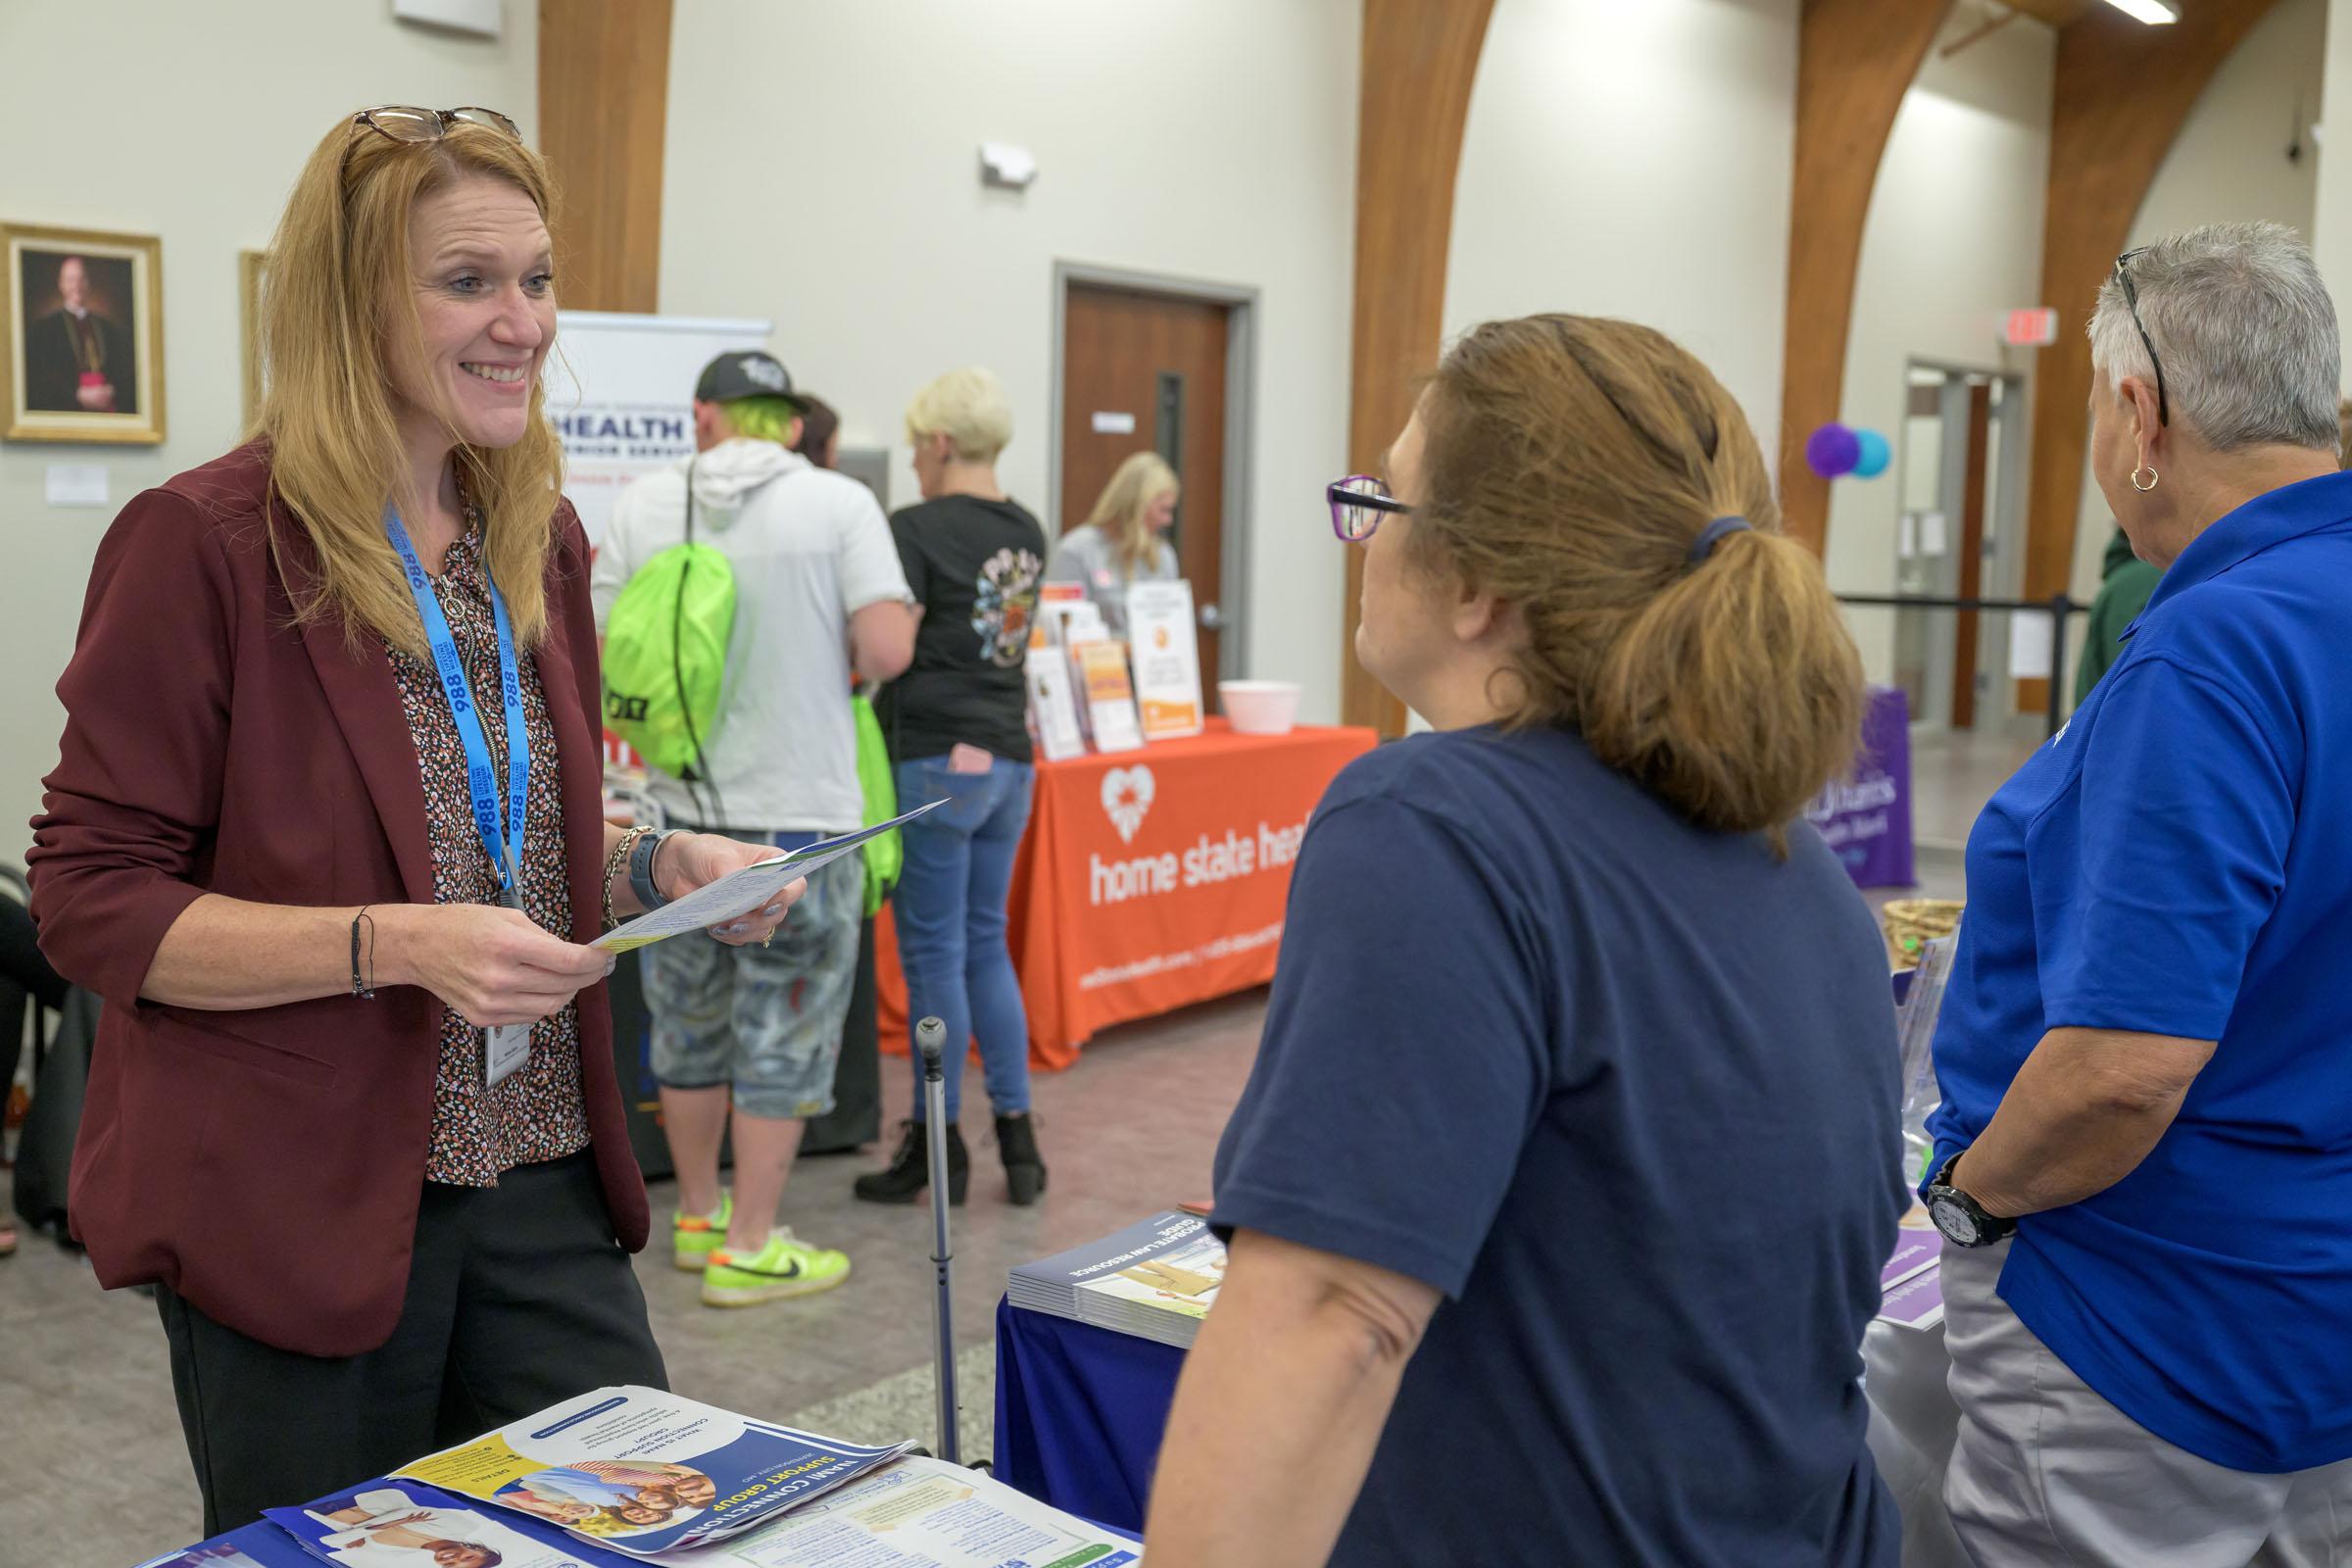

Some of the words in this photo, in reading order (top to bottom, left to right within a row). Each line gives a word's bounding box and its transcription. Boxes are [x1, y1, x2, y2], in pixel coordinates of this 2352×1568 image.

[554, 416, 683, 440] HEALTH
[402, 553, 426, 590] 988
[446, 674, 470, 712] 988
[504, 671, 519, 708] 988
[475, 767, 485, 795] LIFELINE
[480, 766, 489, 795] MISSOURI
[476, 798, 497, 835] 988
[512, 795, 523, 832] 988
[1090, 853, 1179, 906] home
[1182, 833, 1256, 888] state
[1258, 811, 1313, 870] hea
[1154, 1220, 1205, 1247] PROBATE
[1156, 1218, 1195, 1237] GUIDE
[1129, 1243, 1154, 1257] LAW
[1068, 1252, 1134, 1278] RESOURCE
[654, 1418, 709, 1443] CONNECTION
[676, 1429, 702, 1441] WHAT
[614, 1441, 655, 1459] SUPPORT
[470, 1469, 511, 1483] DETAILS
[765, 1456, 836, 1485] SUPPORT
[806, 1459, 858, 1481] NAMI
[686, 1478, 810, 1537] CONNECTION
[712, 1483, 767, 1512] GROUP
